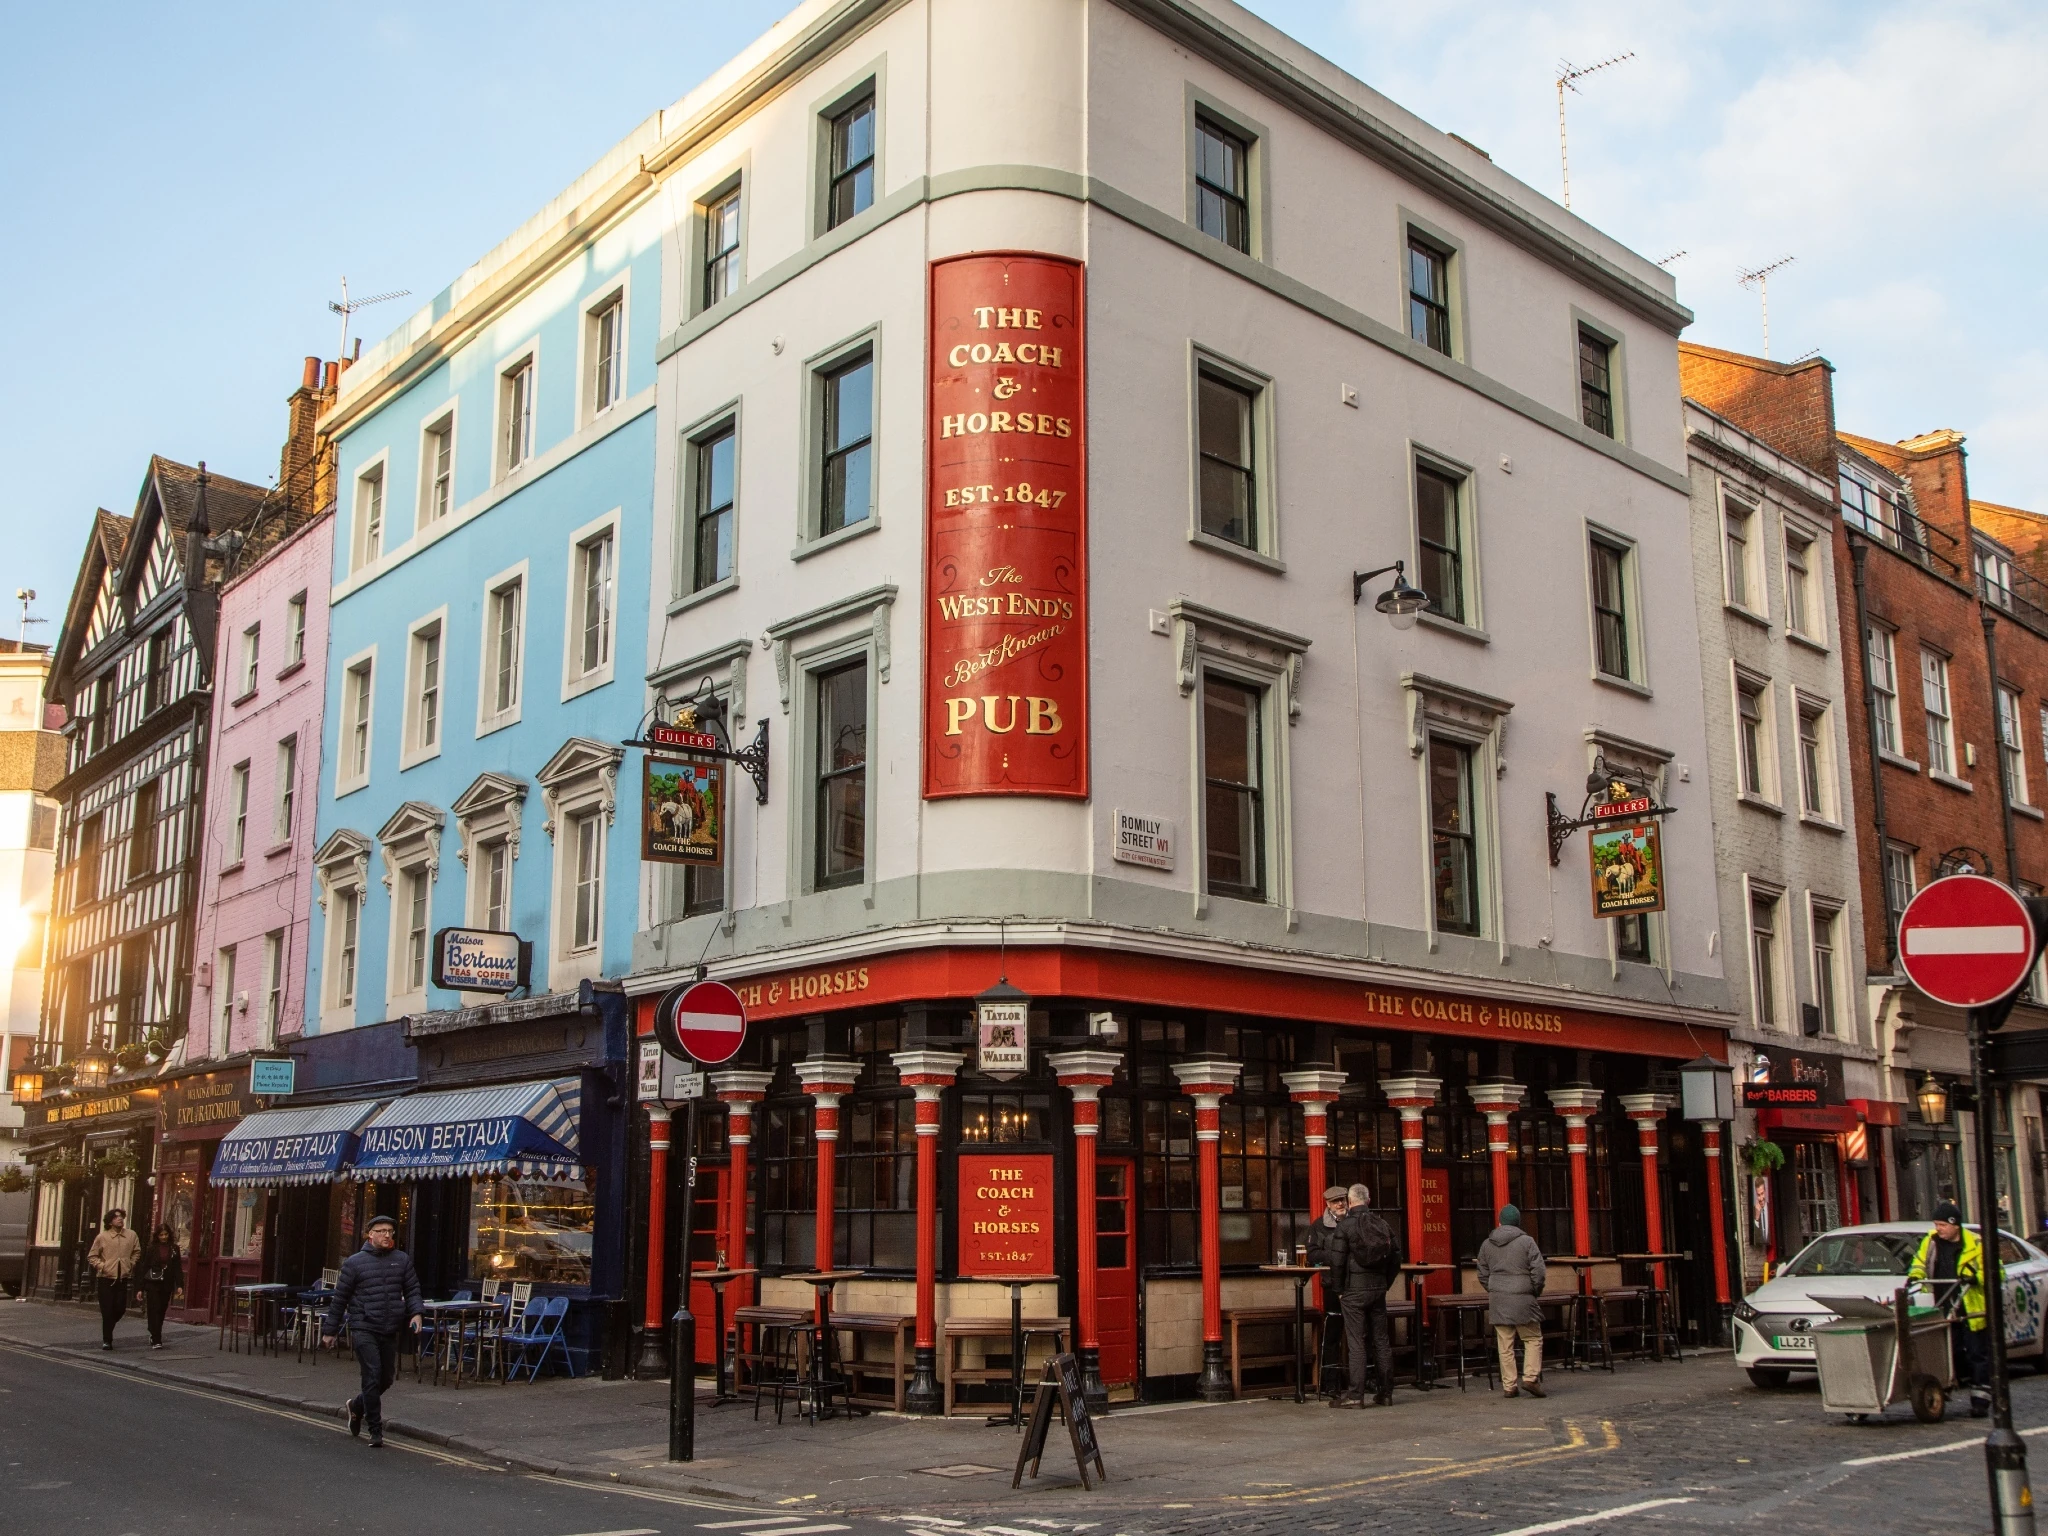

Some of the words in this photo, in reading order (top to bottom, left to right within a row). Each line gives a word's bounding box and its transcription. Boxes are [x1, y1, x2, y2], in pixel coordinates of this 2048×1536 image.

[973, 306, 1043, 330] THE
[948, 342, 1062, 368] COACH
[993, 377, 1022, 400] &
[941, 411, 1072, 439] HORSES
[979, 564, 1023, 587] The
[938, 594, 1003, 621] WEST
[1006, 592, 1073, 620] END'S
[944, 648, 995, 688] Best
[993, 623, 1065, 667] Known
[944, 695, 1063, 736] PUB
[658, 729, 712, 748] FULLER'S
[1597, 801, 1644, 816] FULLER'S
[1122, 815, 1160, 835] ROMILLY
[676, 837, 691, 846] THE
[1122, 831, 1153, 849] STREET
[1156, 838, 1168, 852] W1
[653, 842, 677, 853] COACH
[678, 845, 685, 853] &
[685, 845, 713, 856] HORSES
[1121, 851, 1131, 859] CITY
[1137, 855, 1166, 866] WESTMINSTER
[1601, 900, 1623, 909] COACH
[1629, 895, 1655, 905] HORSES
[1620, 891, 1634, 899] THE
[447, 933, 484, 946] Maison
[446, 944, 517, 970] Bertaux
[444, 975, 478, 985] PATISSERIE
[449, 967, 471, 976] TEAS
[477, 970, 510, 980] COFFEE
[768, 981, 783, 1006] &
[789, 967, 869, 1001] HORSES
[984, 1009, 1021, 1021] TAYLOR
[1365, 991, 1404, 1016] THE
[1411, 996, 1473, 1024] COACH
[1479, 1005, 1492, 1027] &
[1498, 1007, 1563, 1033] HORSES
[983, 1051, 1022, 1063] WALKER
[1768, 1089, 1817, 1102] BARBERS
[47, 1108, 60, 1123] THE
[364, 1127, 426, 1152] MAISON
[431, 1119, 513, 1149] BERTAUX
[219, 1140, 272, 1162] MAISON
[273, 1133, 341, 1160] BERTAUX
[551, 1153, 578, 1163] Classe
[688, 1156, 698, 1187] S13
[989, 1168, 1023, 1181] THE
[1421, 1179, 1438, 1189] THE
[976, 1187, 1034, 1199] COACH
[1422, 1194, 1443, 1204] ACH
[998, 1204, 1012, 1217] &
[1425, 1208, 1433, 1218] &
[973, 1221, 1040, 1234] HORSES
[1423, 1222, 1447, 1232] RSES
[1780, 1337, 1807, 1348] LL22
